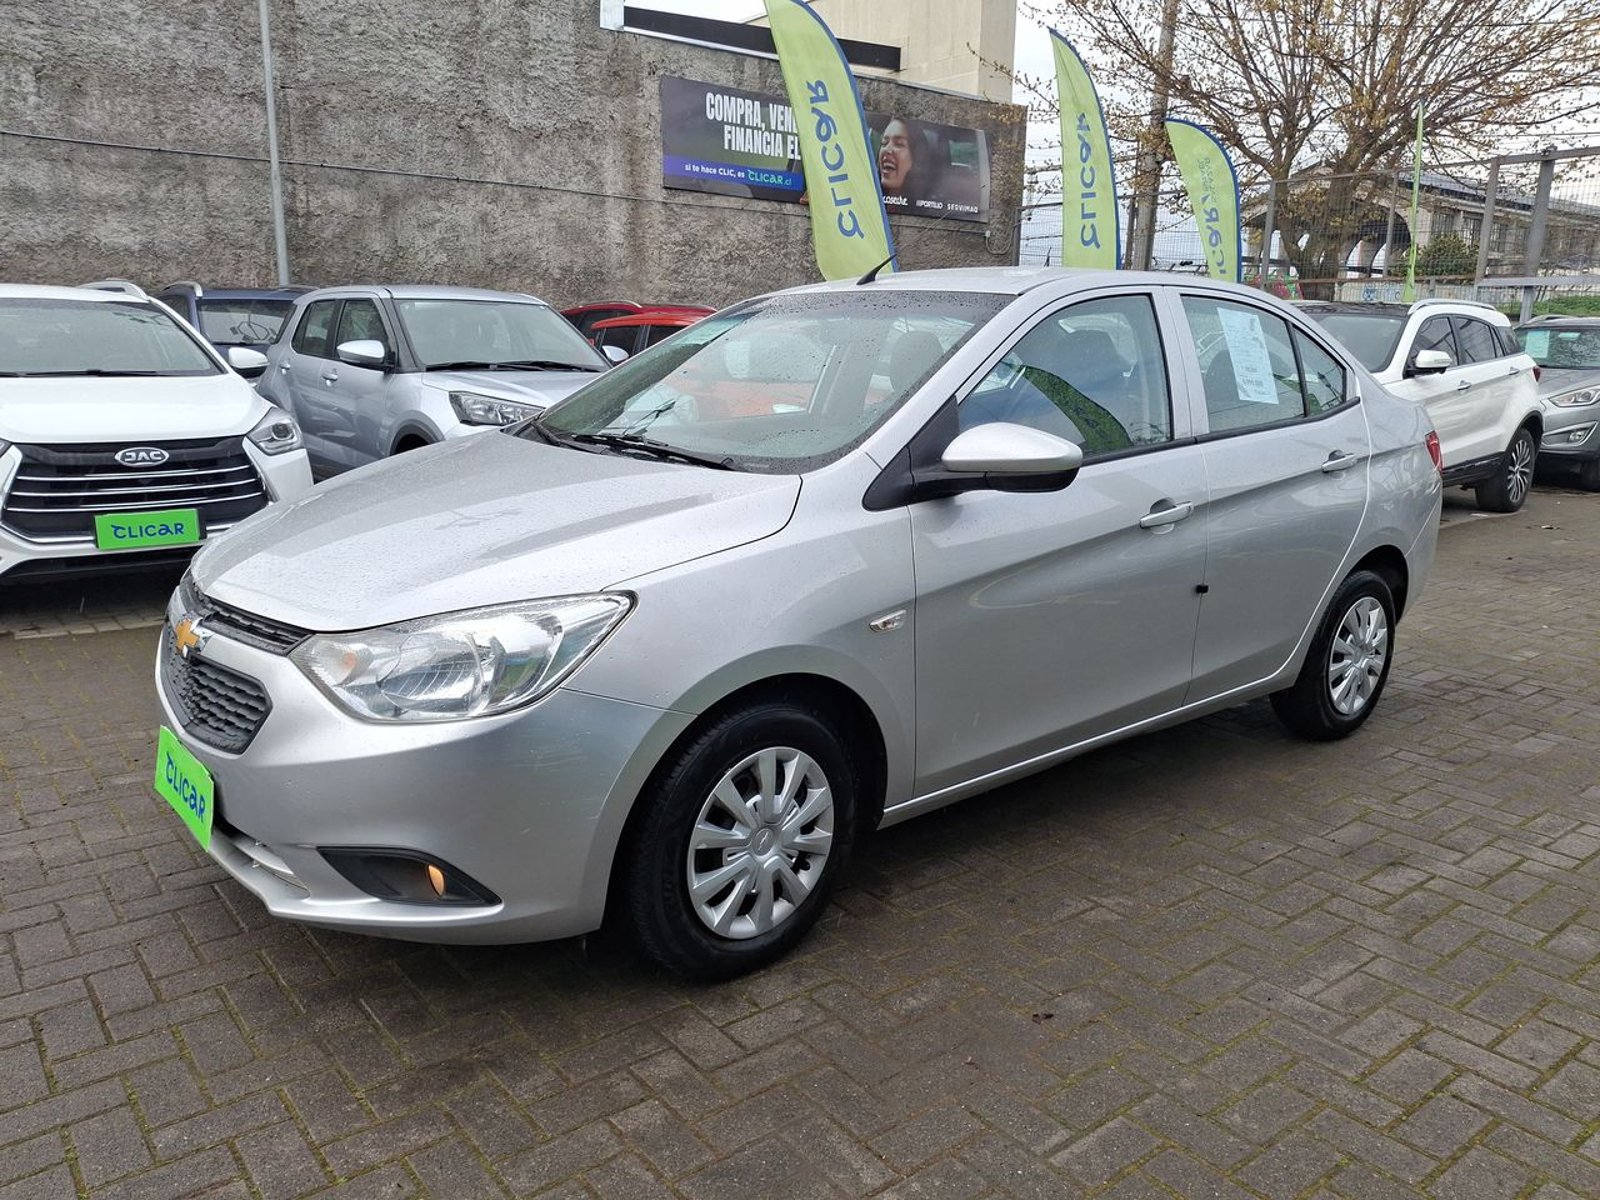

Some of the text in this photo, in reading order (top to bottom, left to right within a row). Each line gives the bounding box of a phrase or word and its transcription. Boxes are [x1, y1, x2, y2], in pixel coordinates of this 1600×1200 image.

[705, 92, 766, 131] COMPRA,
[724, 124, 784, 157] FINANCIA
[692, 164, 700, 172] te
[701, 164, 717, 174] hace
[718, 168, 736, 178] CLIC,
[124, 451, 162, 462] JAC
